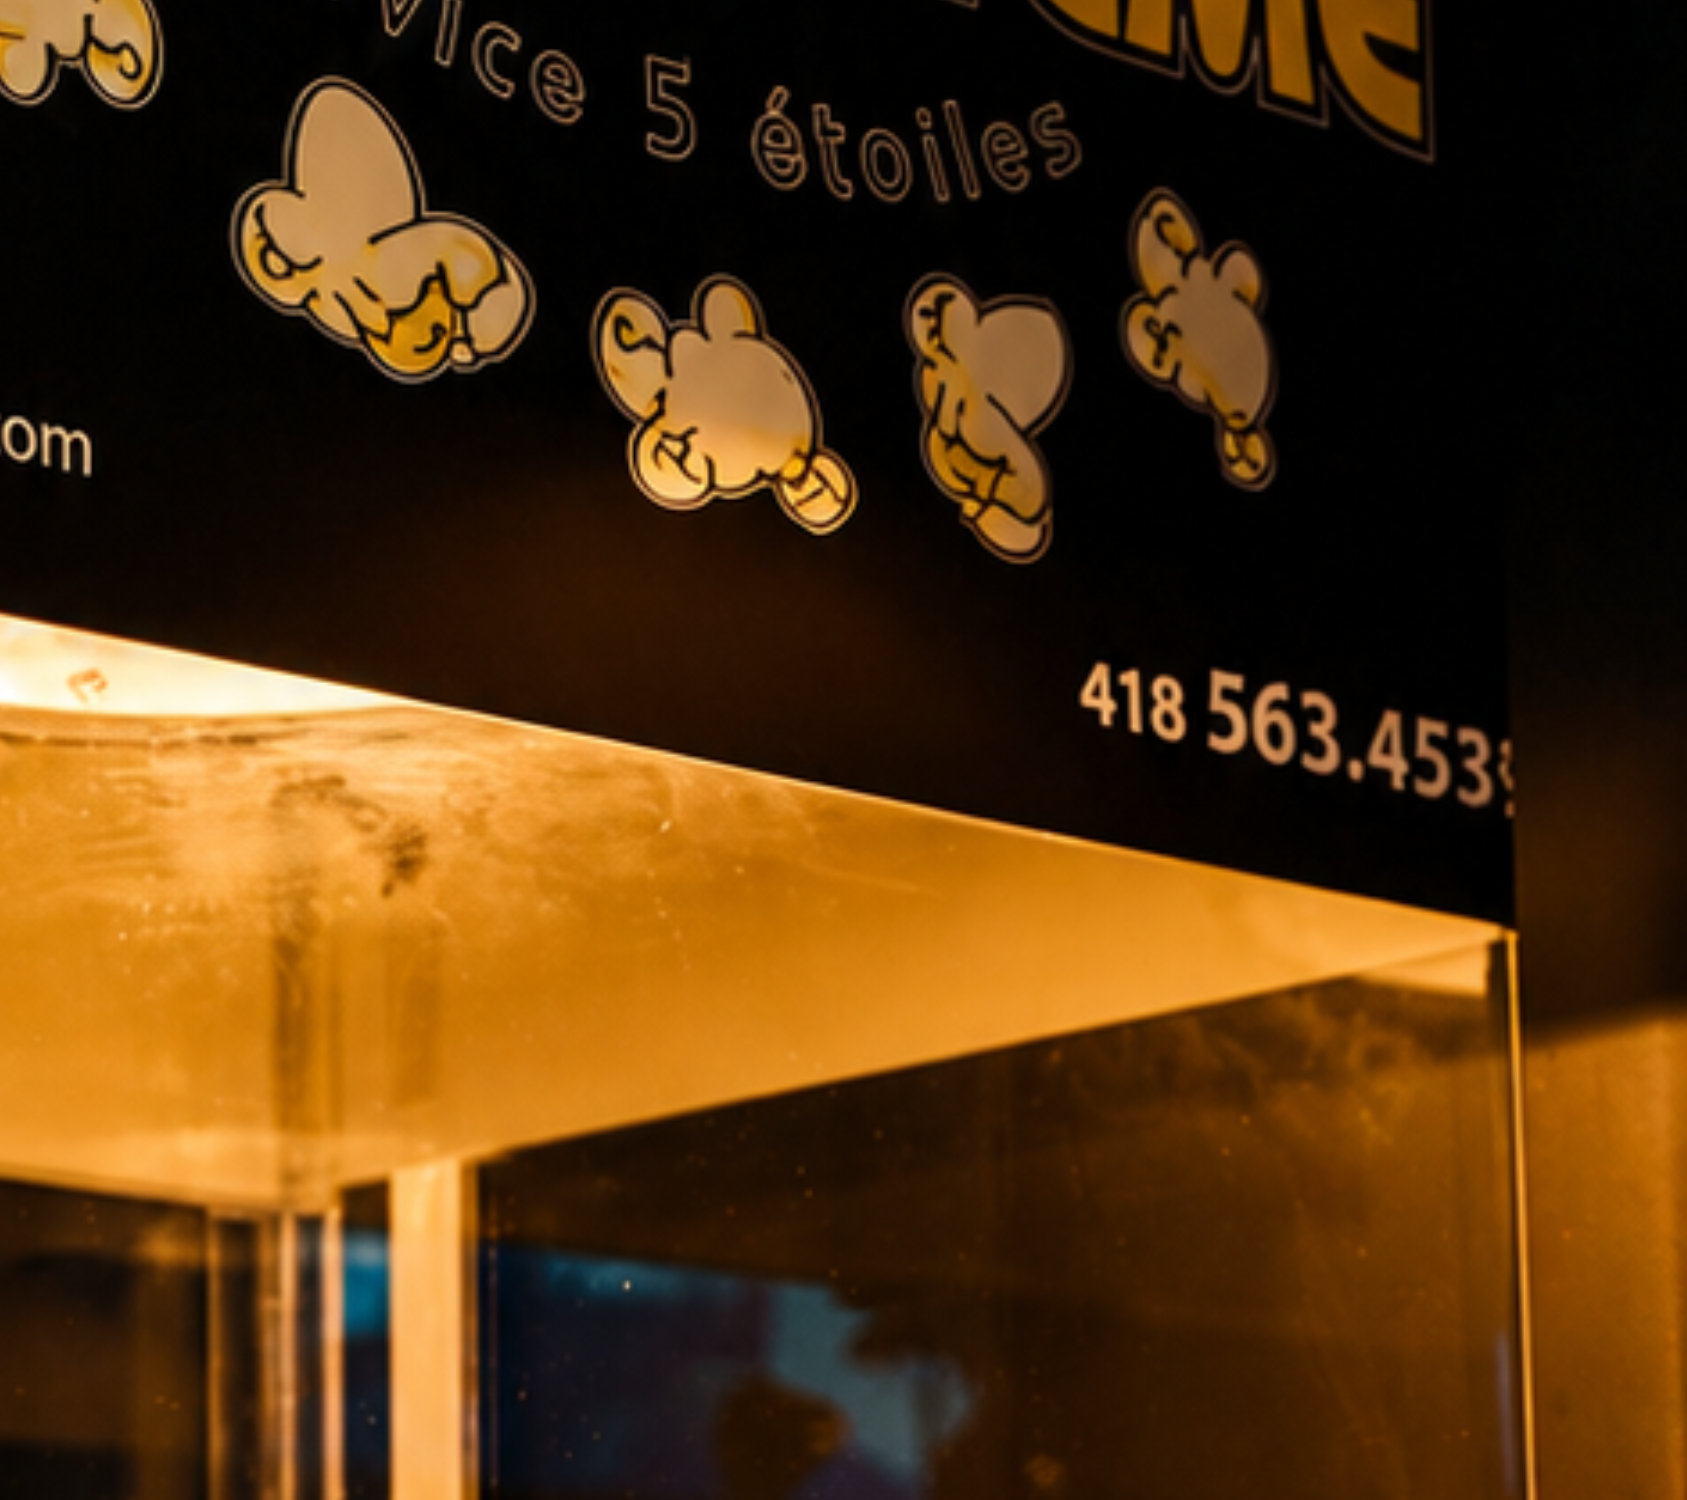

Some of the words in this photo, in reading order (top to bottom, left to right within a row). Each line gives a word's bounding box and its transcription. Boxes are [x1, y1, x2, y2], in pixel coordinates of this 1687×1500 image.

[644, 54, 697, 161] 5
[751, 85, 1084, 202] étoiles
[1079, 661, 1188, 743] 418
